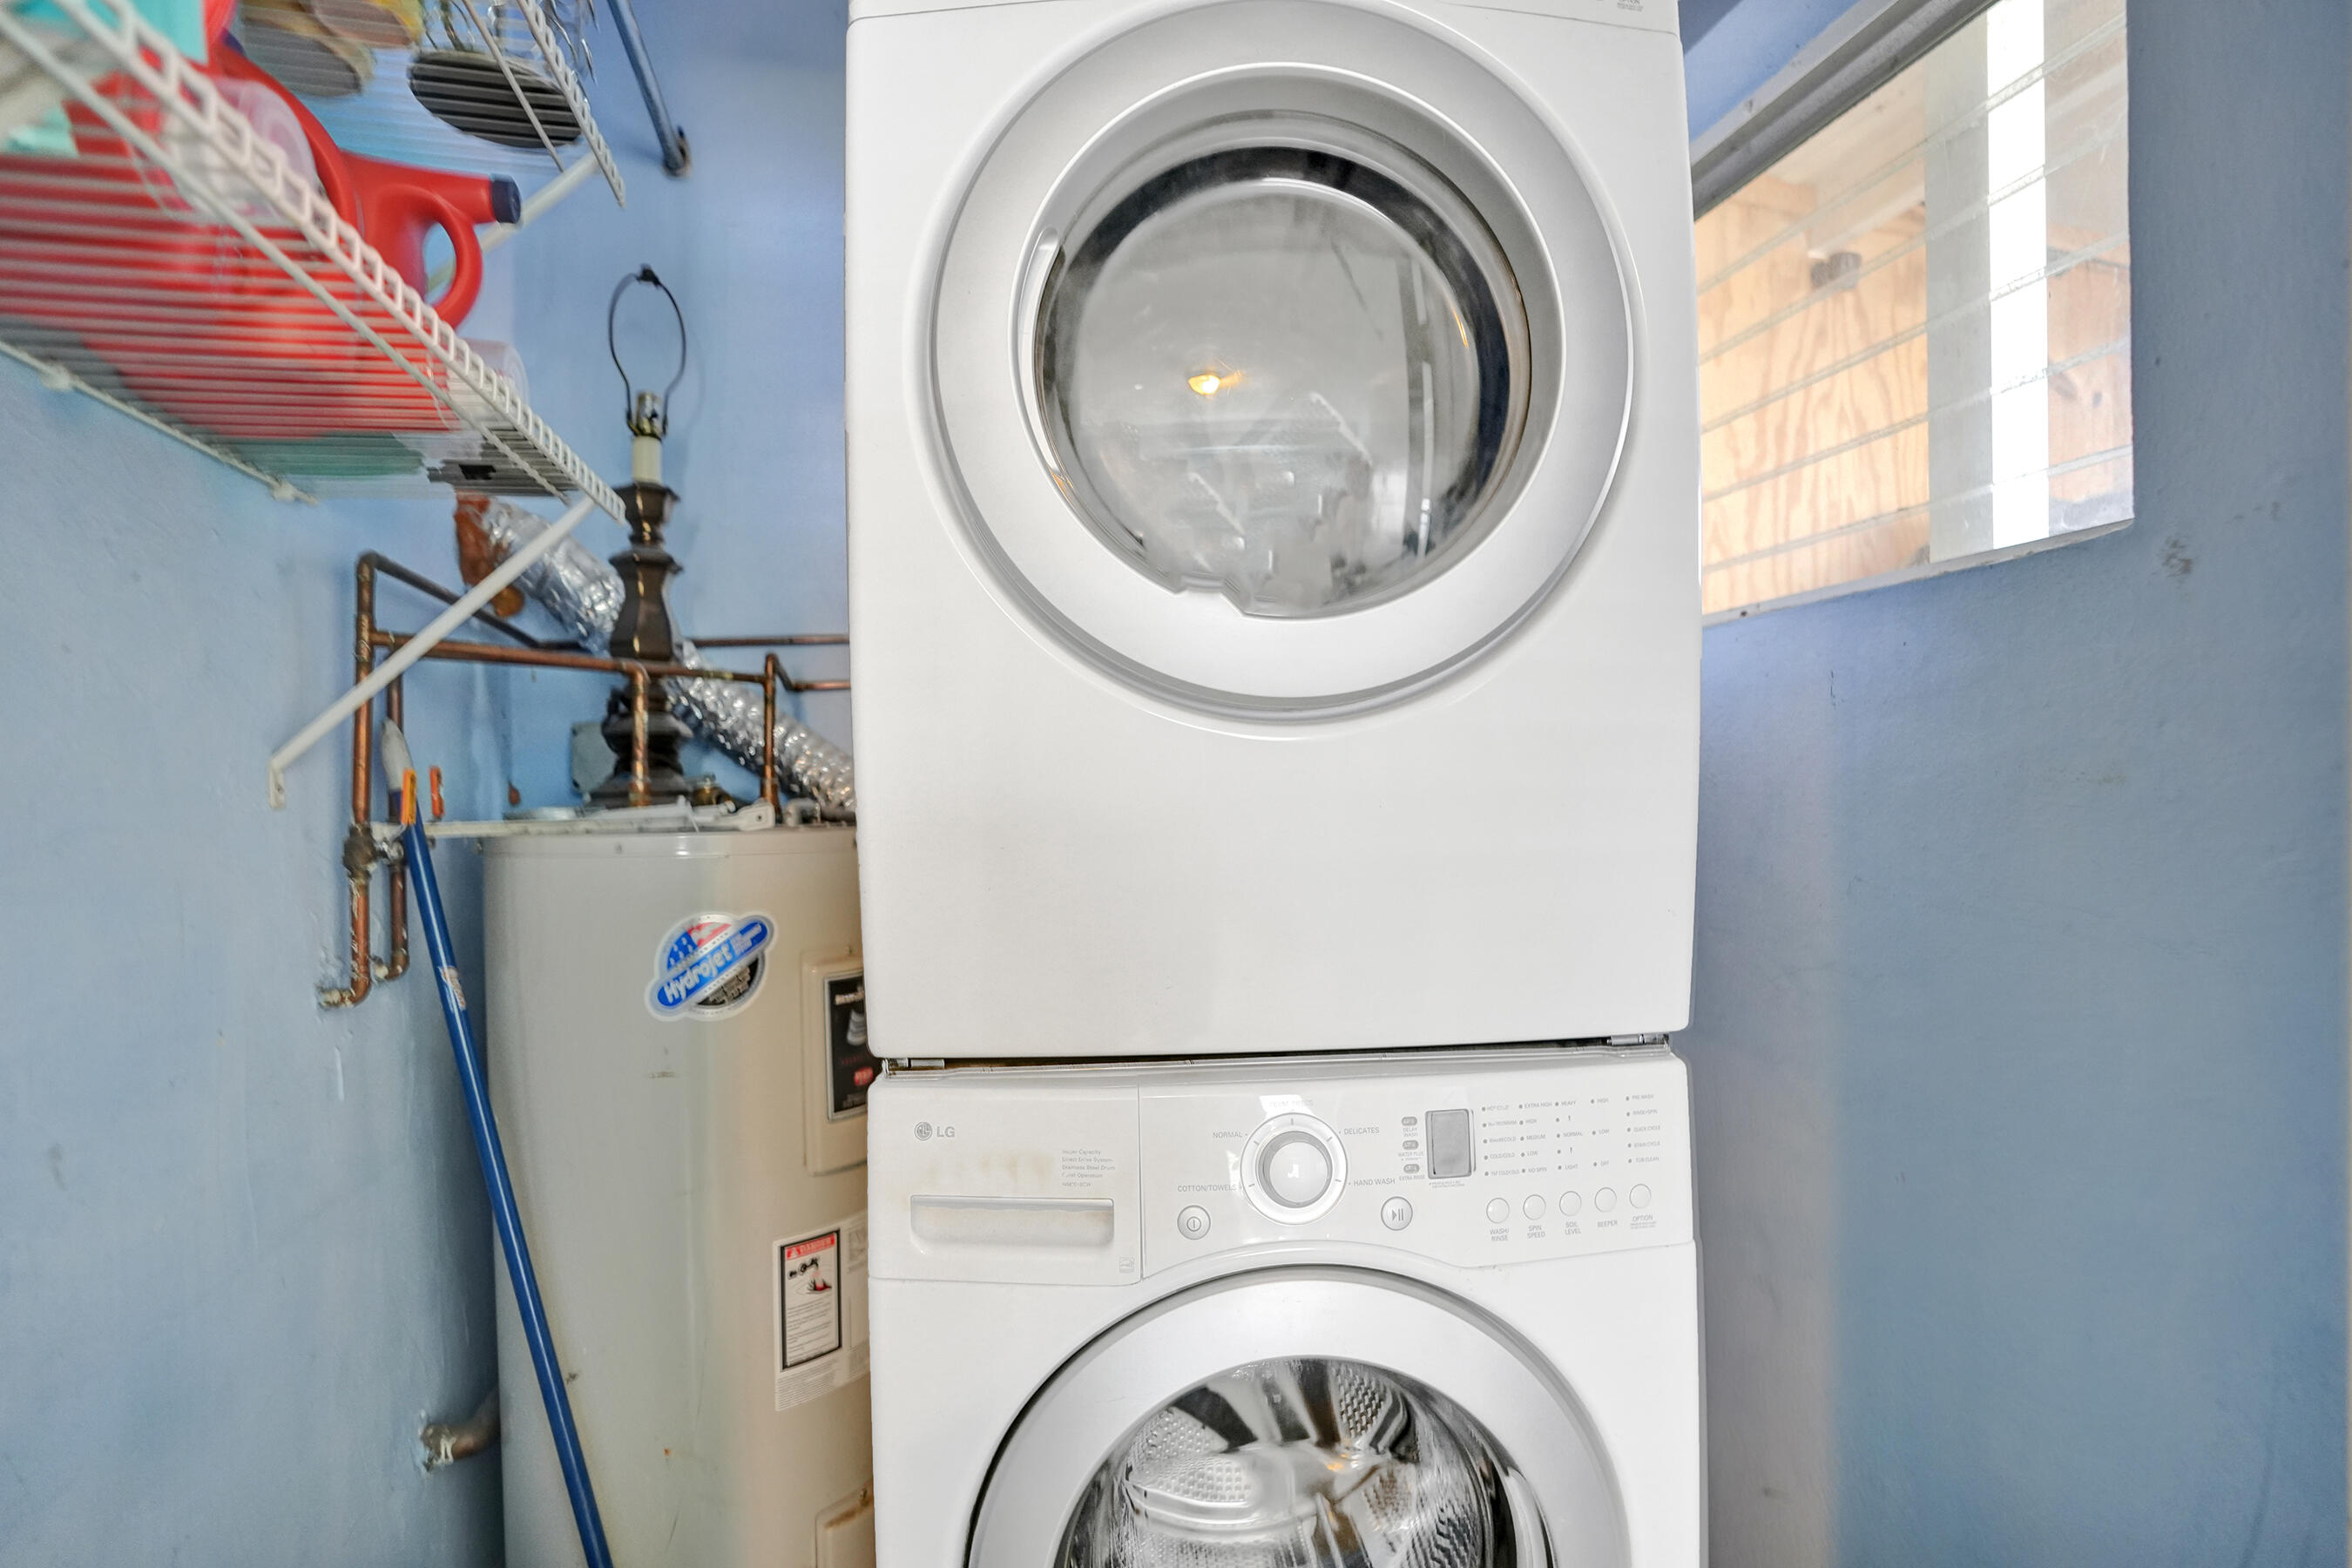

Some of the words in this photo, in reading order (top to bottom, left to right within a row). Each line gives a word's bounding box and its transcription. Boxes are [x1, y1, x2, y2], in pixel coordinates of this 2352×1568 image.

[936, 1125, 956, 1138] LG
[1343, 1126, 1380, 1135] DELICATES
[1177, 1184, 1237, 1193] COTTON/TOWELS
